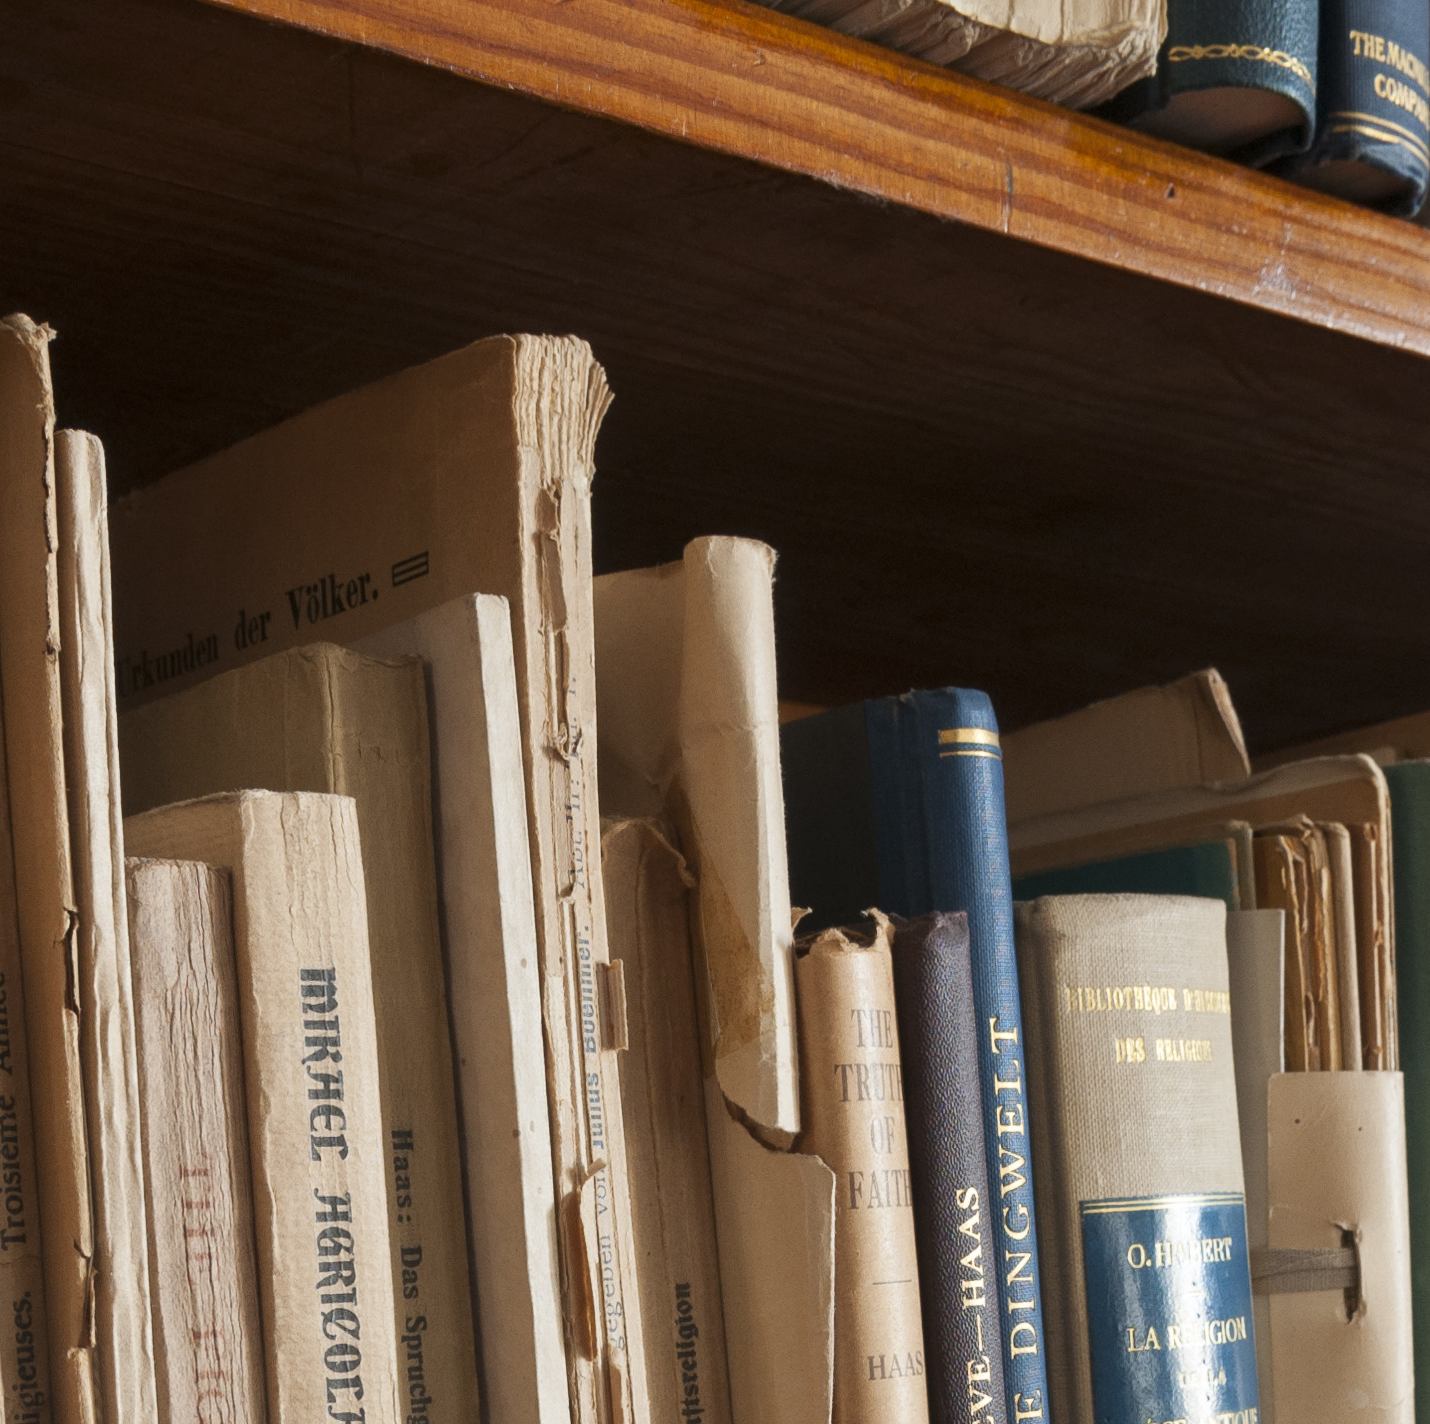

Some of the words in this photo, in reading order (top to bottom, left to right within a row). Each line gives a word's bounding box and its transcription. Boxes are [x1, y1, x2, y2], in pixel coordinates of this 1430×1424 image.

[1349, 29, 1386, 62] THE
[234, 609, 271, 651] der
[285, 572, 378, 631] Völker.
[851, 1009, 893, 1048] THE
[1116, 1037, 1146, 1063] DES
[299, 966, 349, 1162] MIKAEL
[870, 1117, 895, 1154] OF
[390, 1129, 415, 1225] Haas:
[988, 1016, 1039, 1360] DINGWELT
[955, 1186, 986, 1310] HAAS
[400, 1246, 424, 1300] Das
[1127, 1327, 1161, 1352] LA
[867, 1352, 924, 1380] HAAS
